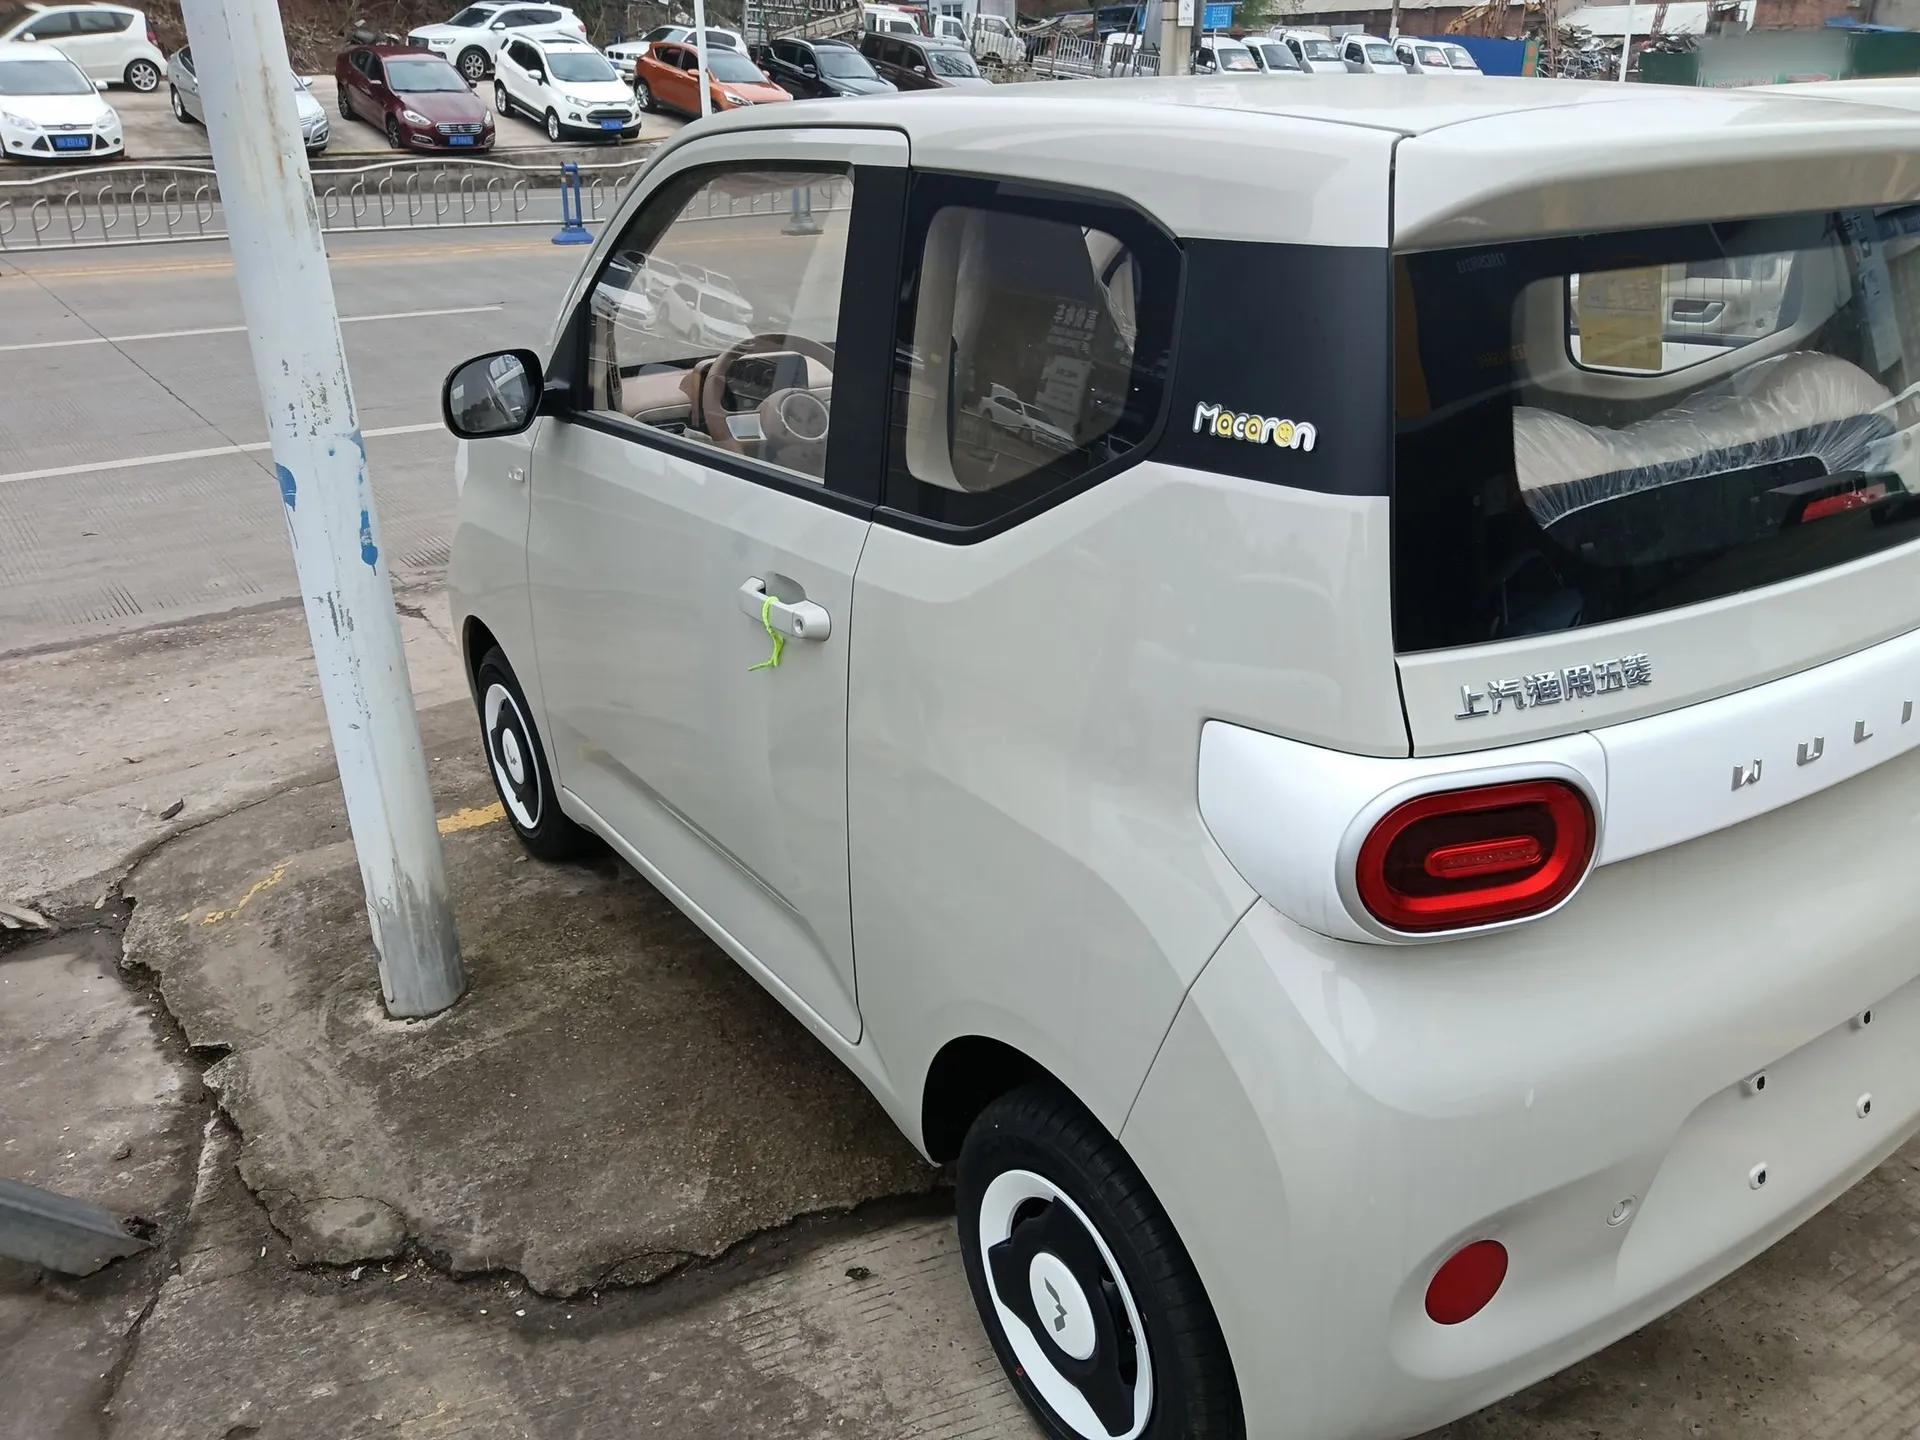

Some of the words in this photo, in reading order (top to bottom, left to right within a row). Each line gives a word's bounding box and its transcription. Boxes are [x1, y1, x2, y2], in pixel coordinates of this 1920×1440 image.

[1193, 401, 1317, 452] Macaron
[1455, 652, 1652, 720] 上汽通用五菱
